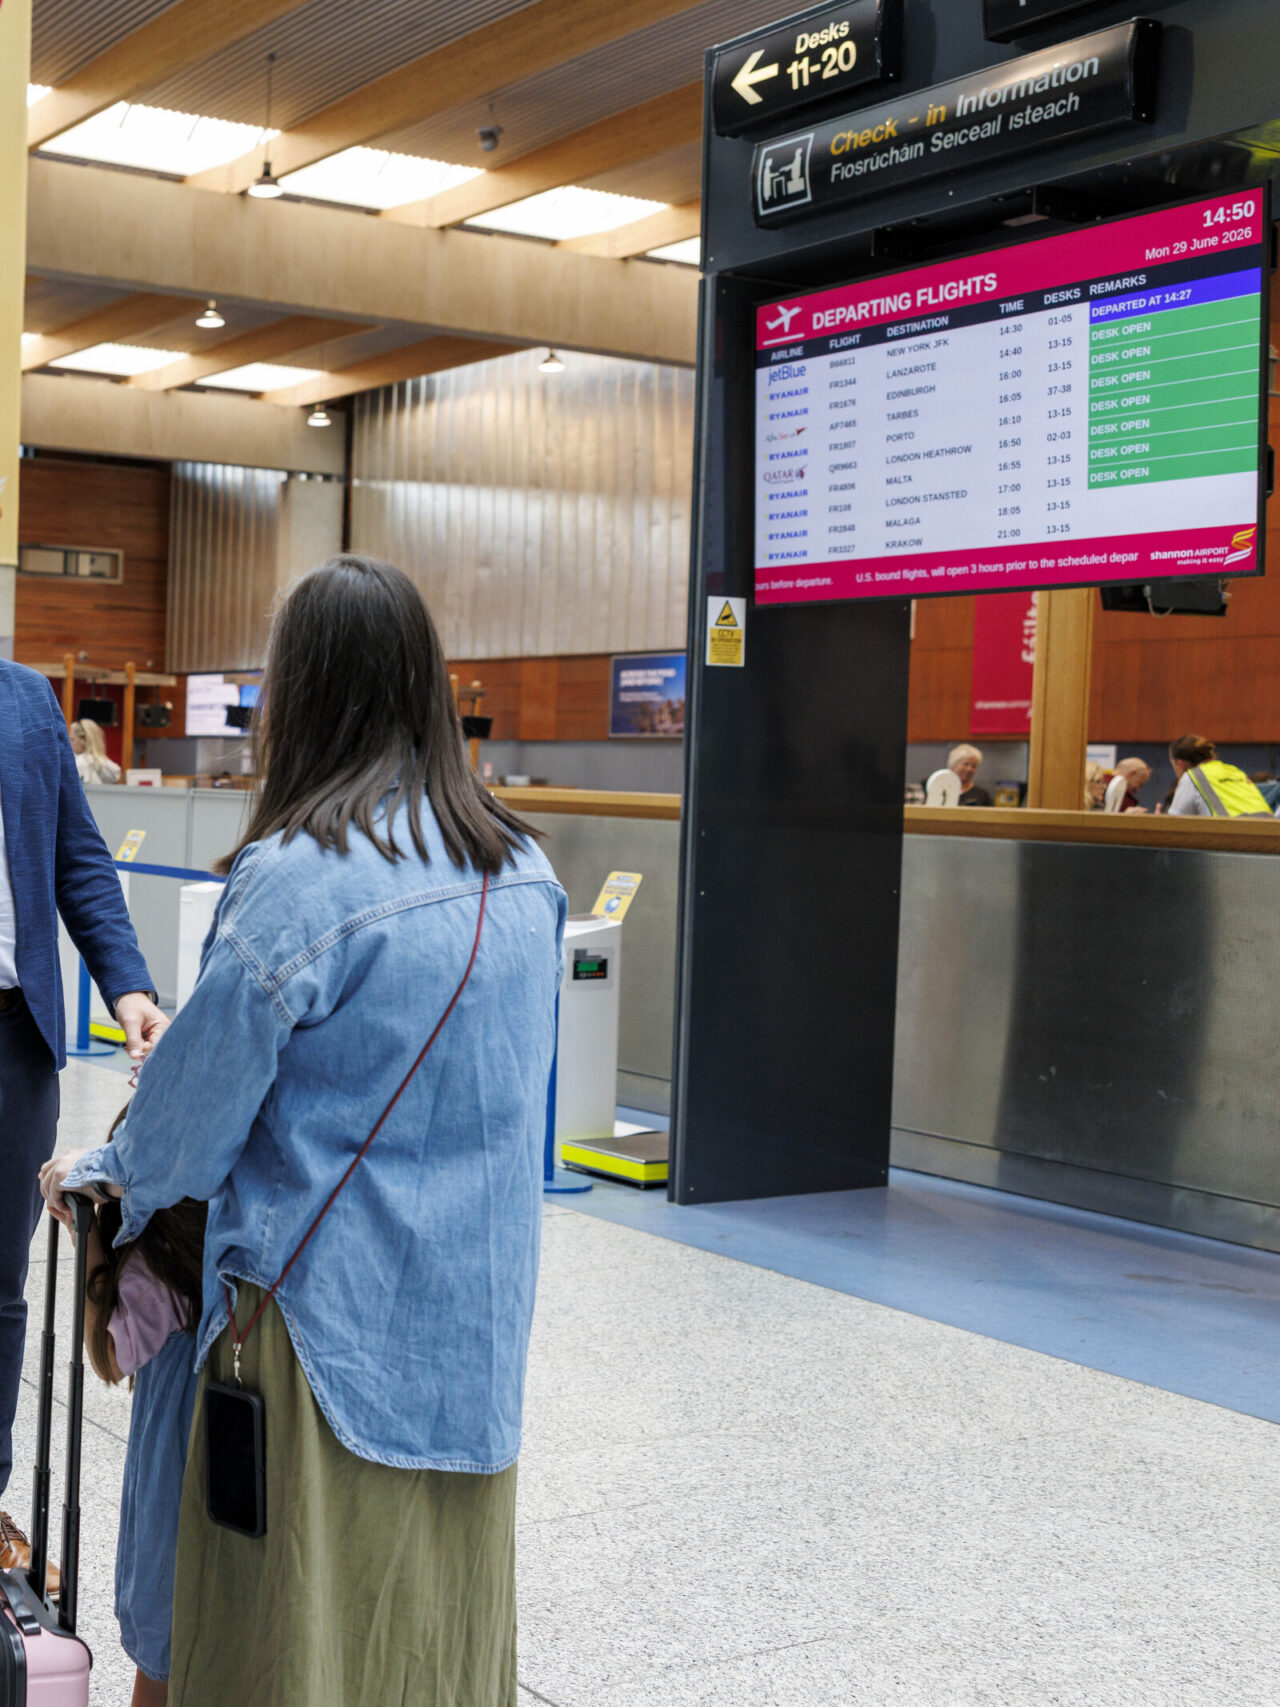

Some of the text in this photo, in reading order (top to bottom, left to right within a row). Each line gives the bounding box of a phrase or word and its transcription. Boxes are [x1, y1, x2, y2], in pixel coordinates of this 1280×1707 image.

[795, 20, 850, 55] Desks
[786, 40, 857, 91] 11-20
[829, 117, 899, 156] Check
[925, 103, 947, 127] in
[956, 56, 1099, 118] Information
[1203, 200, 1255, 227] 14:50
[1145, 227, 1252, 261] Mon 29 June 2026
[770, 274, 1147, 362] AIRLINE FLIGHT DESTINATION TIME DESKS REMARKS
[812, 272, 997, 330] DEPARTING FLIGHTS
[768, 364, 807, 386] jetBlue
[886, 347, 906, 358] NEW
[908, 342, 931, 353] YORK
[933, 338, 949, 349] JFK
[1000, 324, 1023, 336] 14:30
[1048, 314, 1073, 326] 01-05
[1092, 298, 1146, 317] DEPARTED
[1148, 295, 1162, 306] AT
[1164, 289, 1192, 303] 14:27
[769, 387, 809, 401] RYANAIR
[886, 362, 937, 379] LANZAROTE
[999, 346, 1022, 358] 14:40
[1048, 337, 1072, 349] 13-15
[1091, 327, 1119, 341] DESK
[1122, 321, 1151, 335] OPEN
[769, 408, 809, 421] RYANAIR
[886, 385, 936, 400] EDINBURGH
[999, 369, 1022, 381] 16:00
[1048, 361, 1072, 372] 13-15
[1091, 351, 1119, 364] DESK
[1121, 346, 1151, 359] OPEN
[886, 409, 919, 421] TARBES
[999, 392, 1022, 404] 16:05
[1047, 384, 1072, 396] 37-38
[1091, 375, 1119, 388] DESK
[1121, 370, 1151, 383] OPEN
[763, 469, 793, 482] QATAR
[886, 452, 921, 464] LONDON
[923, 445, 972, 459] HEATHROW
[998, 438, 1021, 449] 16:50
[1047, 431, 1071, 442] 02-03
[1090, 423, 1118, 435] DESK
[1121, 419, 1150, 431] OPEN
[769, 448, 808, 461] RYANAIR
[886, 432, 915, 443] PORTO
[999, 415, 1022, 426] 16:10
[1047, 408, 1072, 419] 13-15
[1090, 399, 1118, 412] DESK
[1121, 395, 1150, 408] OPEN
[769, 489, 808, 500] RYANAIR
[886, 475, 912, 485] MALTA
[998, 460, 1021, 472] 16:55
[1047, 454, 1071, 465] 13-15
[1090, 447, 1118, 459] DESK
[1120, 443, 1150, 456] OPEN
[769, 510, 808, 520] RYANAIR
[886, 496, 920, 507] LONDON
[923, 490, 967, 503] STANSTED
[998, 483, 1021, 494] 17:00
[1047, 477, 1071, 488] 13-15
[1090, 470, 1117, 483] DESK
[1120, 467, 1150, 480] OPEN
[769, 530, 808, 541] RYANAIR
[886, 517, 920, 528] MALAGA
[998, 506, 1021, 516] 18:05
[1047, 500, 1071, 511] 13-15
[769, 550, 808, 560] RYANAIR
[886, 538, 923, 549] KRAKOW
[997, 528, 1021, 539] 21:00
[1046, 523, 1070, 534] 13-15
[856, 551, 1139, 583] U.S. bound flights, will open 3 hours prior to the scheduled depar
[1150, 547, 1229, 561] shannon AIRPORT
[1177, 558, 1201, 566] making
[1209, 556, 1223, 565] easy
[771, 578, 794, 590] before
[795, 576, 834, 590] departure.
